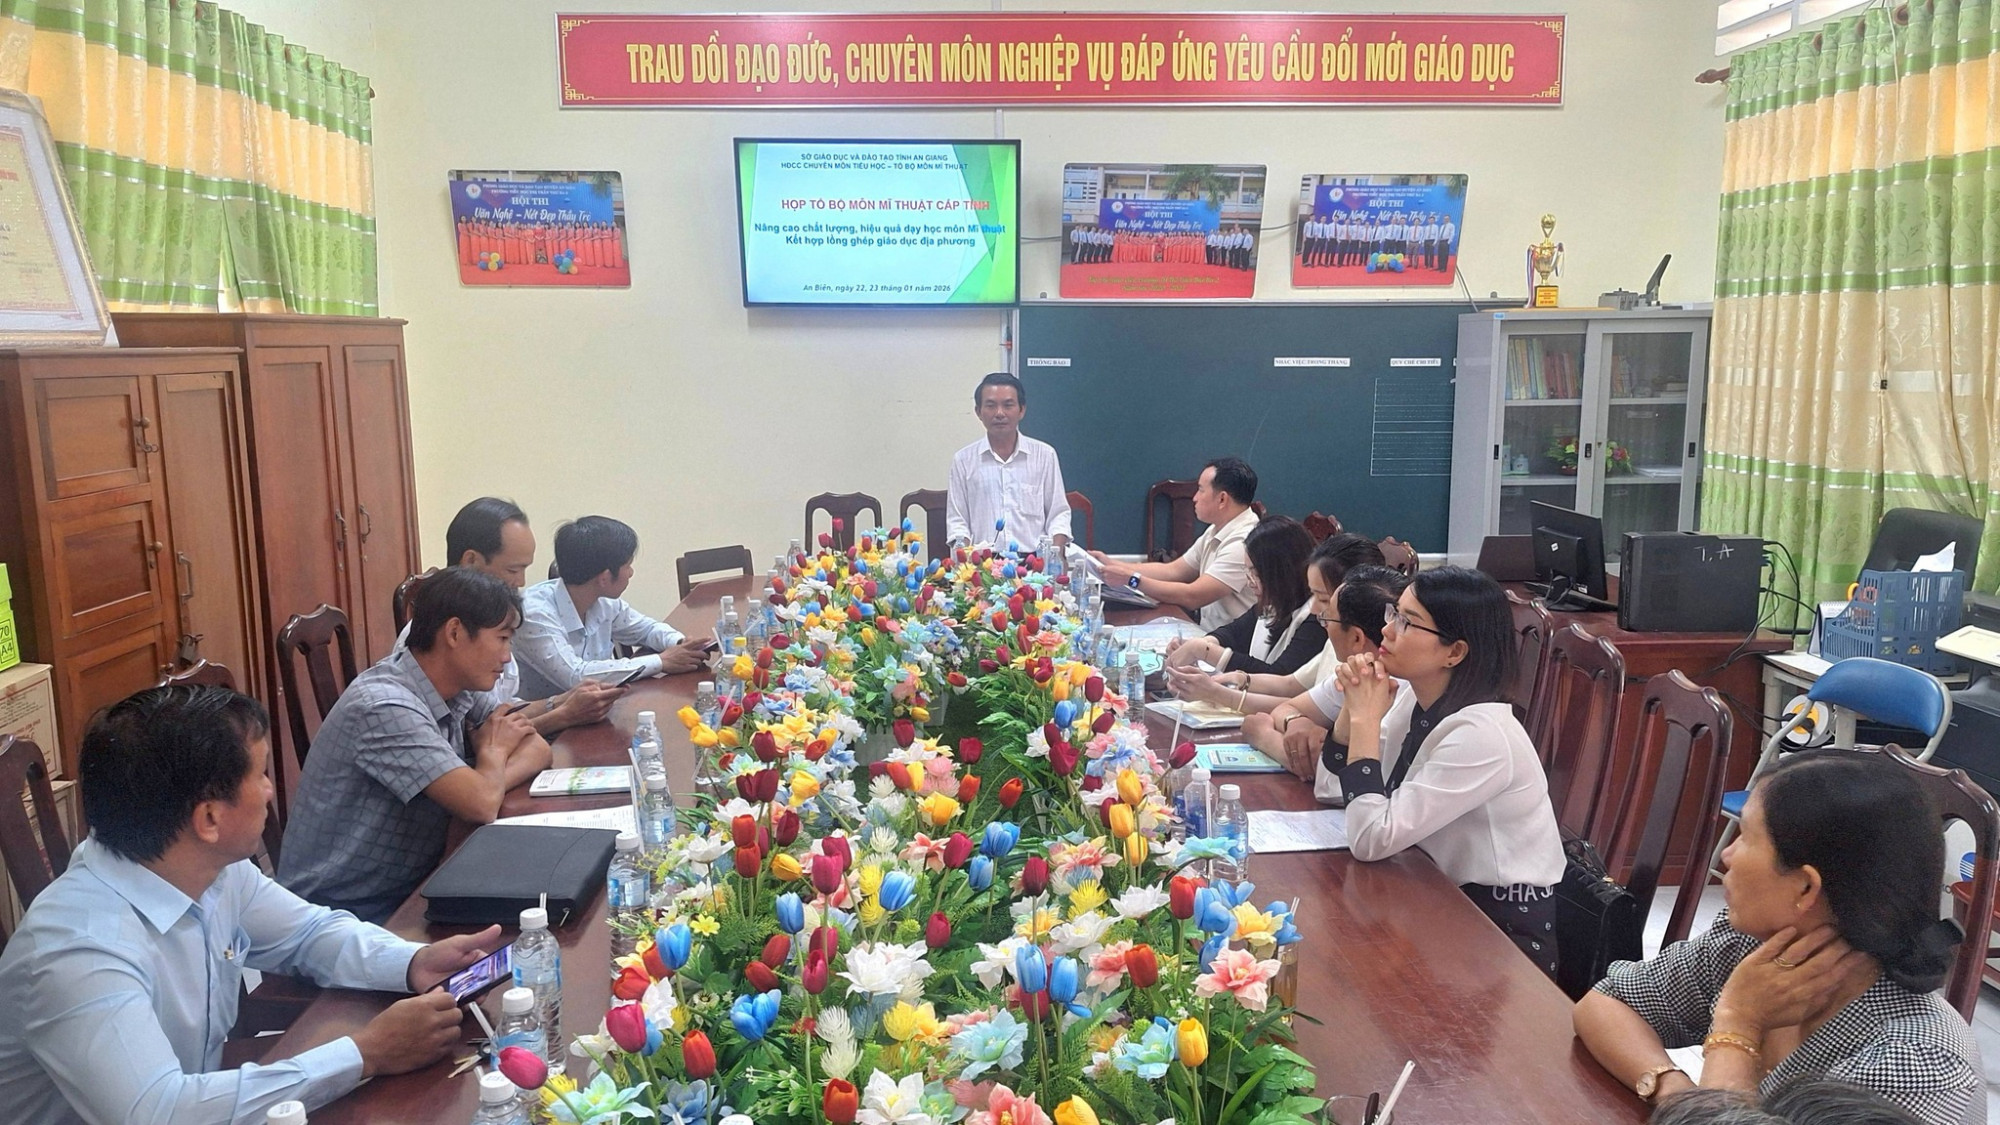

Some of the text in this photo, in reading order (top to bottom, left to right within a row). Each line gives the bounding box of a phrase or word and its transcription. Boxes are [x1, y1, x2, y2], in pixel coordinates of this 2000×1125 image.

[626, 26, 1516, 93] TRAU DỒI ĐẠO ĐỨC, CHUYÊN MÔN NGHIỆP VỤ ĐÁP ỨNG YÊU CẦU ĐỔI MỚI GIÁO DỤC
[925, 154, 948, 162] GIANG
[512, 196, 549, 207] HỘI THI
[781, 199, 806, 212] HỌP
[829, 198, 846, 212] BỘ
[849, 197, 875, 210] MÔN
[895, 198, 933, 213] THUẬT
[1369, 198, 1404, 209] HỘI THI
[754, 223, 780, 234] Nâng
[782, 225, 800, 233] cao
[802, 222, 823, 233] chất
[826, 224, 858, 234] lượng,
[860, 224, 881, 234] hiệu
[884, 224, 902, 235] quả
[904, 224, 921, 235] dạy
[923, 224, 942, 235] học
[944, 224, 965, 233] môn
[786, 234, 976, 247] Kết hợp lồng ghép giáo dục địa phương
[881, 285, 902, 293] tháng
[915, 284, 932, 292] năm
[1, 642, 13, 657] A4
